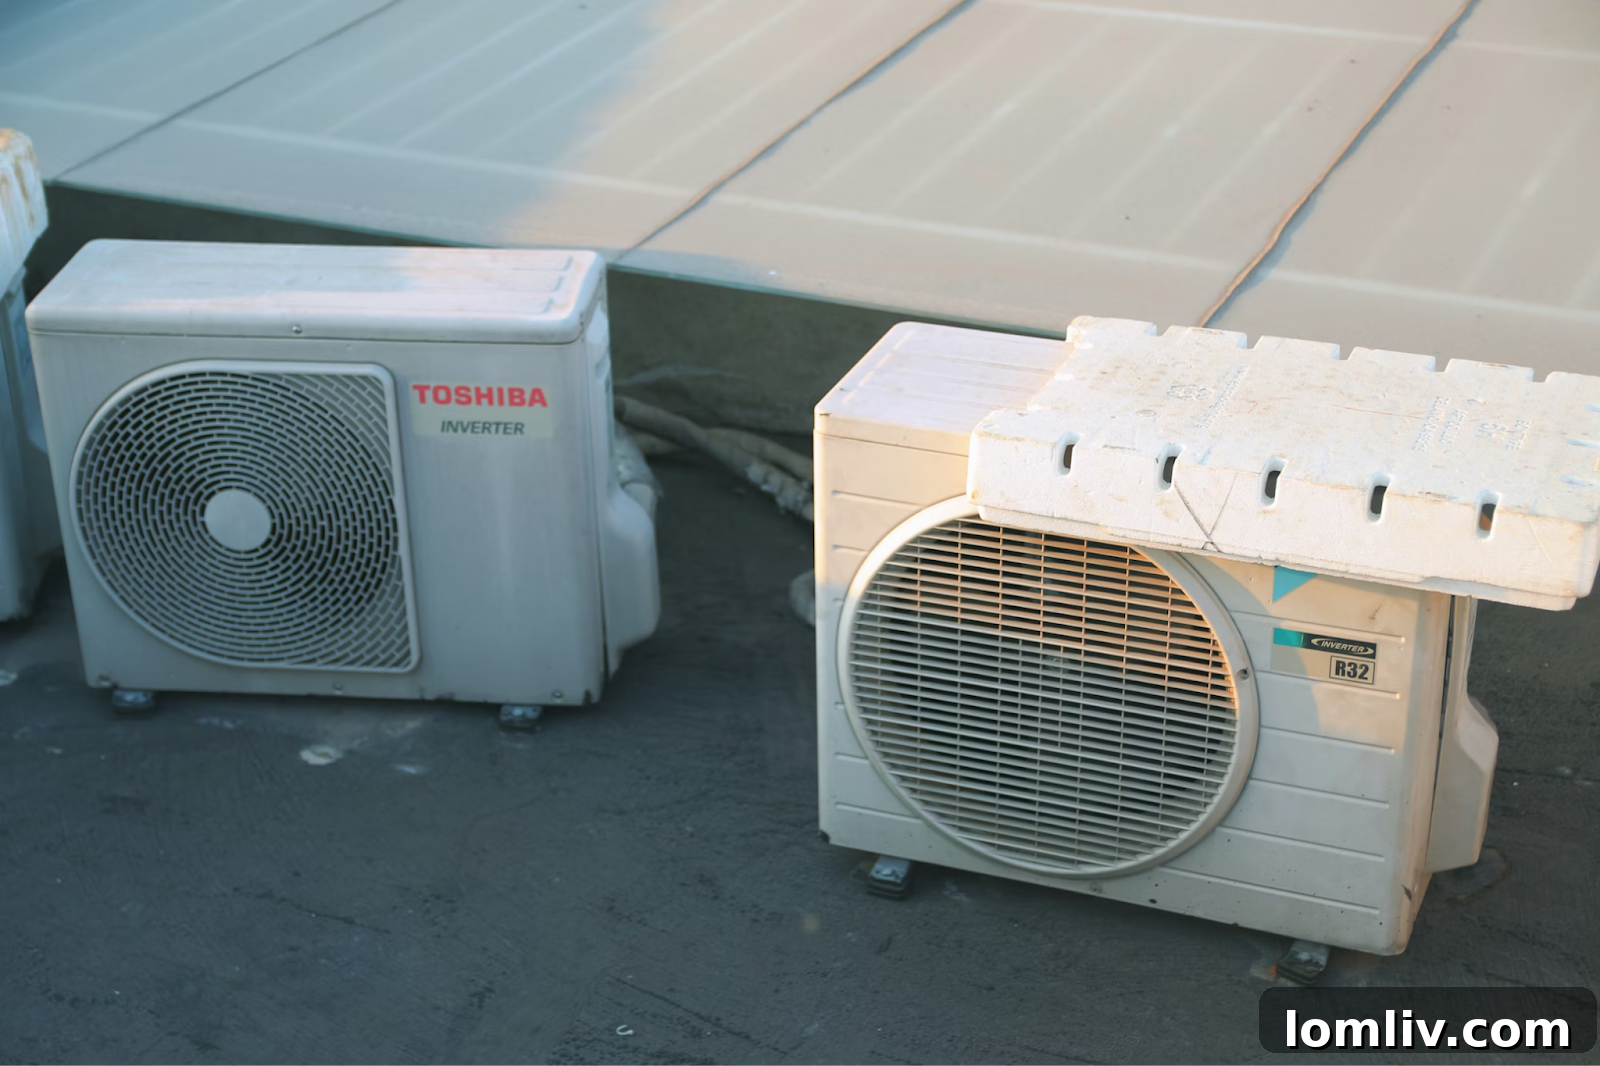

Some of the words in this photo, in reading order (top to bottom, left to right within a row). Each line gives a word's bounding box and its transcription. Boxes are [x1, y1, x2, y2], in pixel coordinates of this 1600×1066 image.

[412, 385, 548, 408] TOSHIBA
[440, 420, 525, 435] INVERTER
[1320, 640, 1364, 653] INVERTER
[1335, 660, 1369, 680] R32
